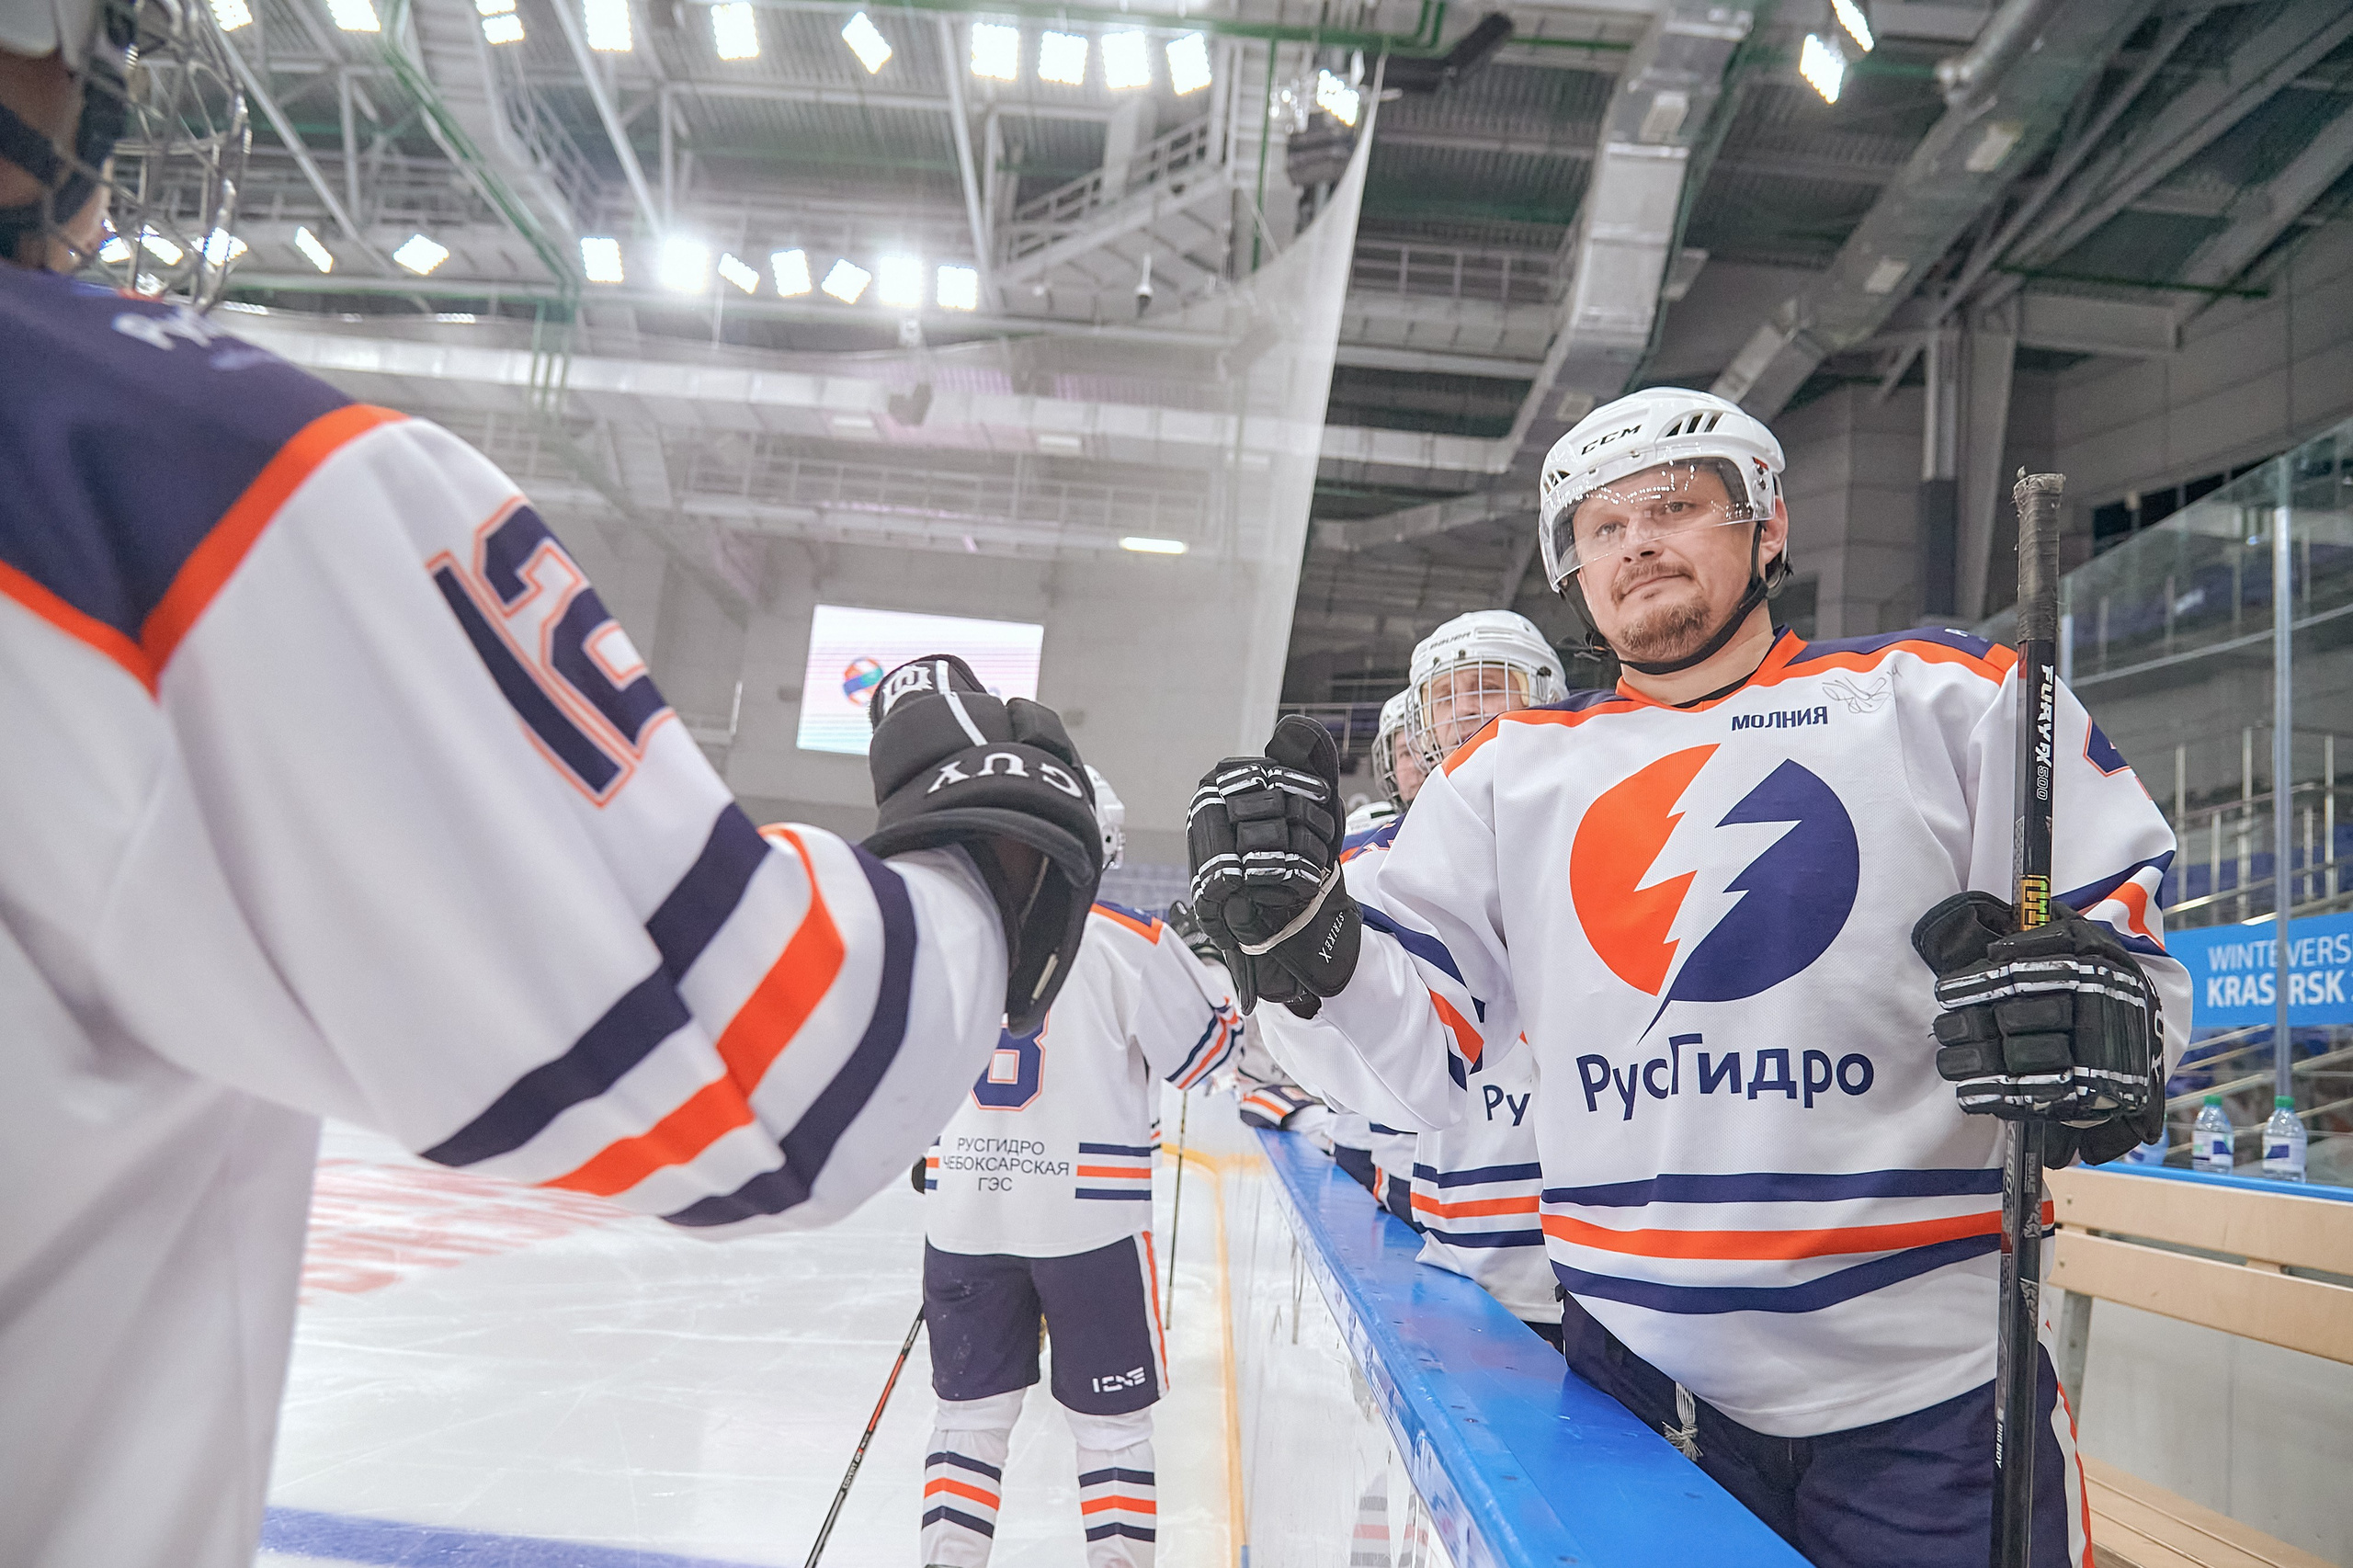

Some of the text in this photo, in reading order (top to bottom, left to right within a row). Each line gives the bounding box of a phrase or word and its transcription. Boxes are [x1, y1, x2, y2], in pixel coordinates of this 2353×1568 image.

[1581, 424, 1642, 456] CCM
[1732, 706, 1828, 731] МОЛНИЯ
[2036, 664, 2054, 742] FURY
[927, 752, 1083, 798] GUY
[2207, 939, 2279, 972] WINTE
[1576, 1033, 1875, 1120] РусГидро
[1483, 1085, 1530, 1126] Ру
[957, 1137, 1045, 1155] РУСГИДРО
[943, 1155, 1070, 1176] ЧЕБОКСАРСКАЯ
[978, 1177, 1013, 1191] ГЭС
